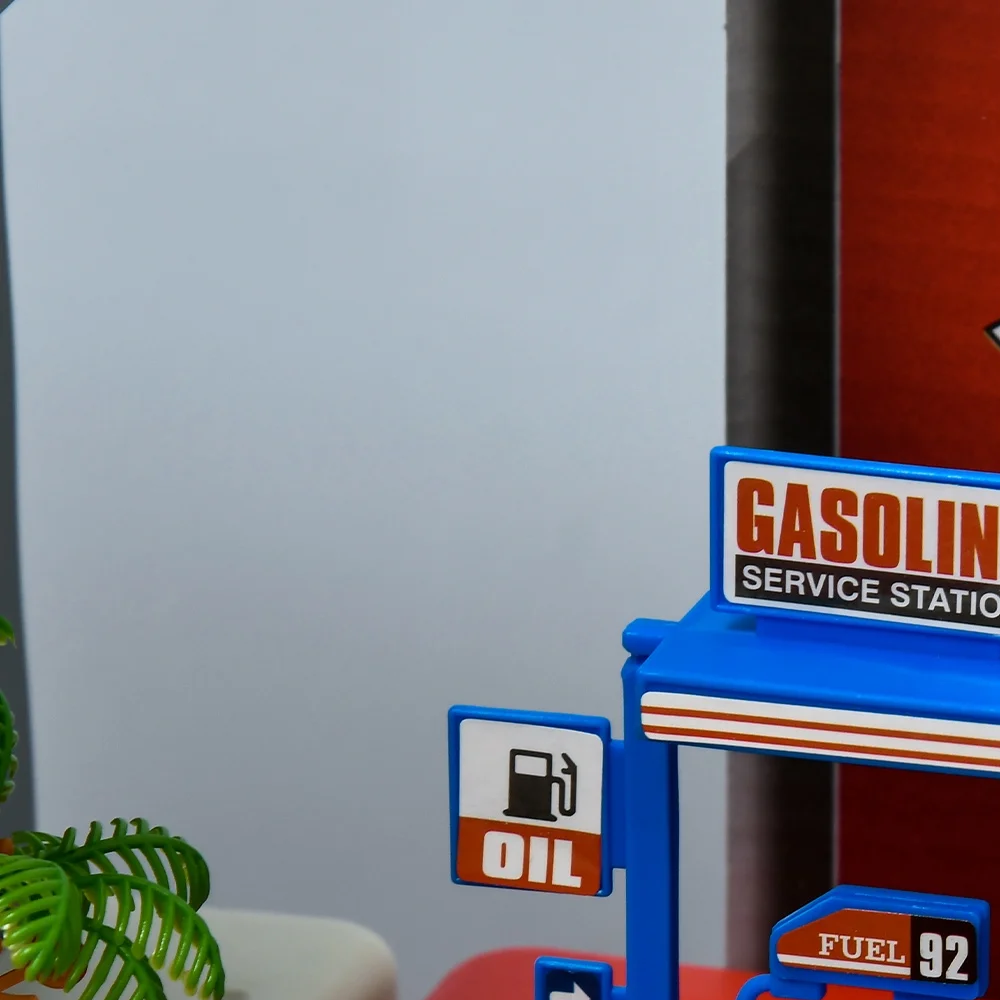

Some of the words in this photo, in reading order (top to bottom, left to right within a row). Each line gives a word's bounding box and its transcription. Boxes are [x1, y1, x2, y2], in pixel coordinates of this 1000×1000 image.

[742, 564, 880, 604] SERVICE
[482, 830, 582, 888] OIL
[818, 932, 906, 964] FUEL
[919, 932, 969, 981] 92
